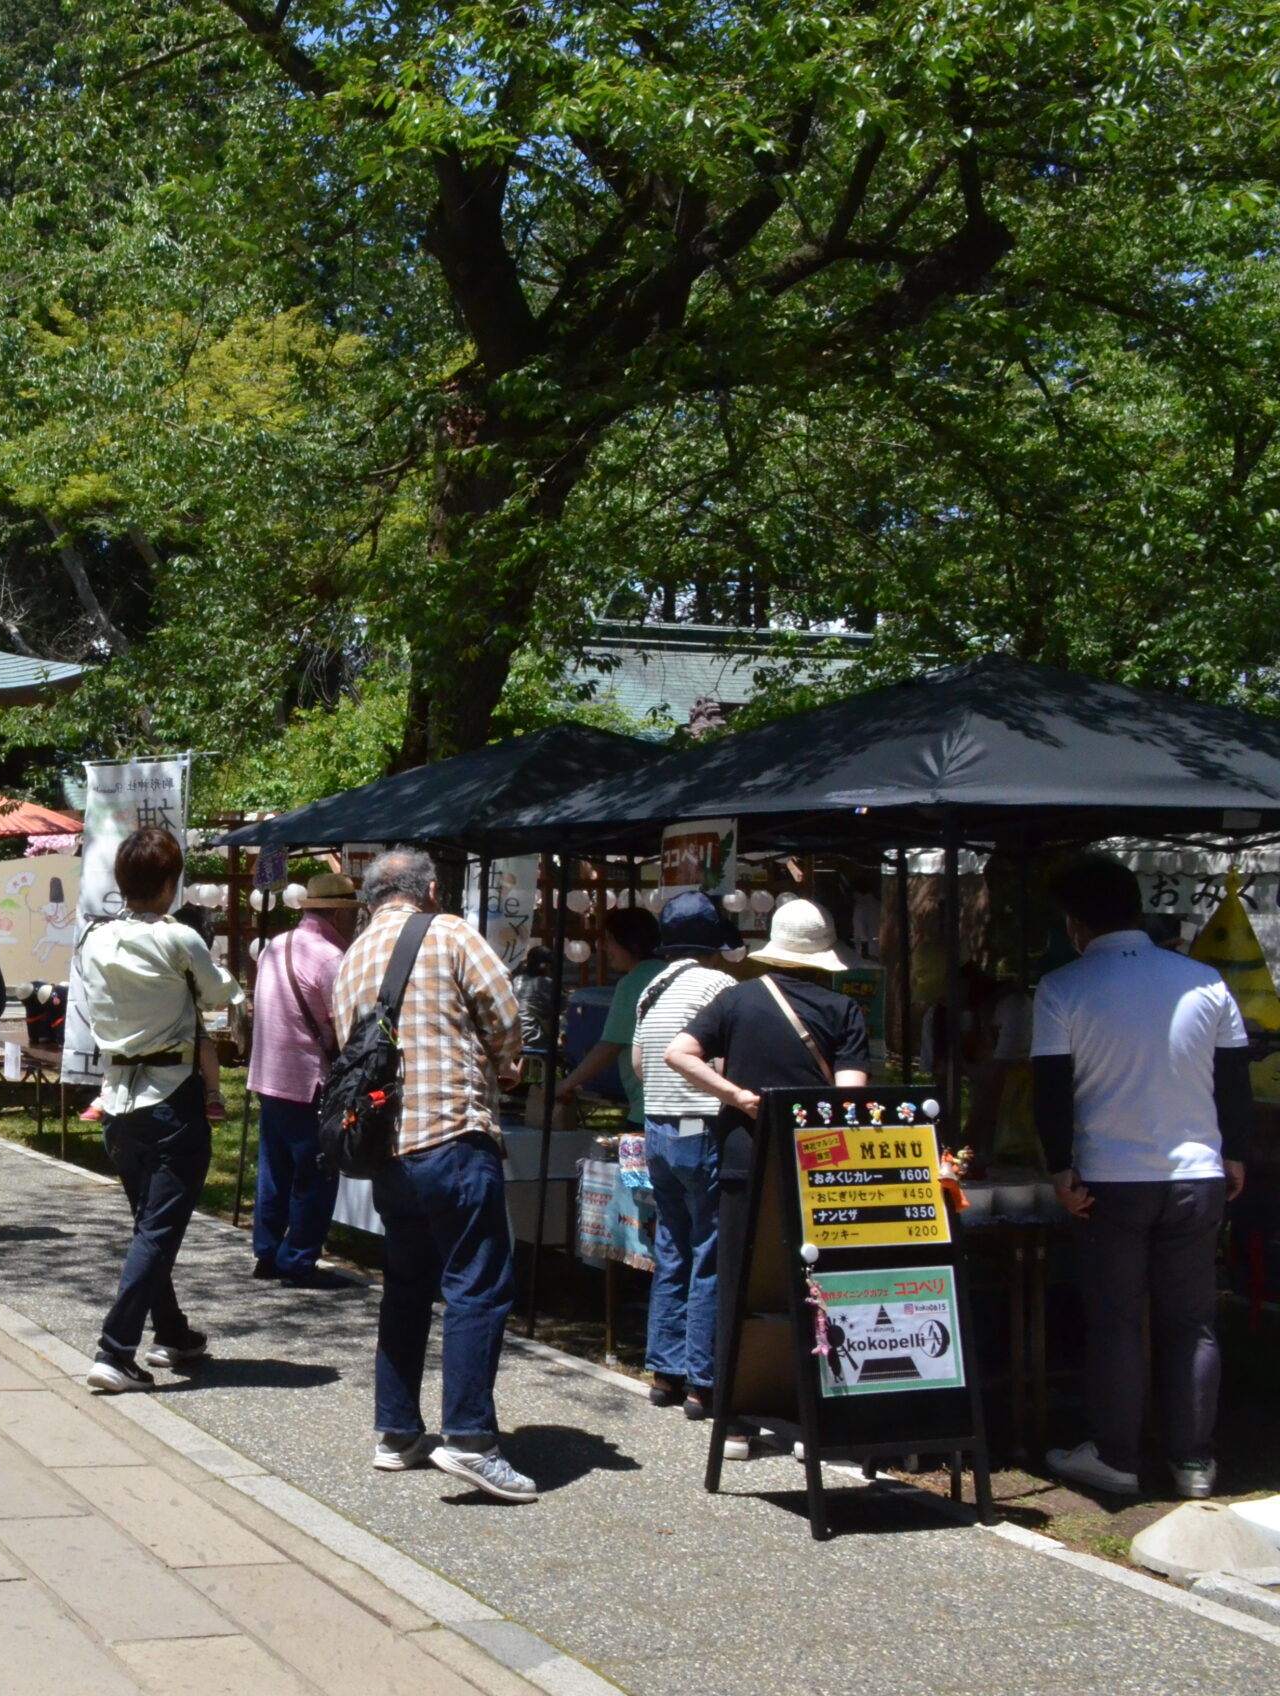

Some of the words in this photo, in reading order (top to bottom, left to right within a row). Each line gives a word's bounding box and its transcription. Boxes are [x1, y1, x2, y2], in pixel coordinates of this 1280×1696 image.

[1149, 874, 1280, 910] おみく
[860, 1140, 924, 1160] MENU
[847, 1333, 926, 1353] kokopelli
